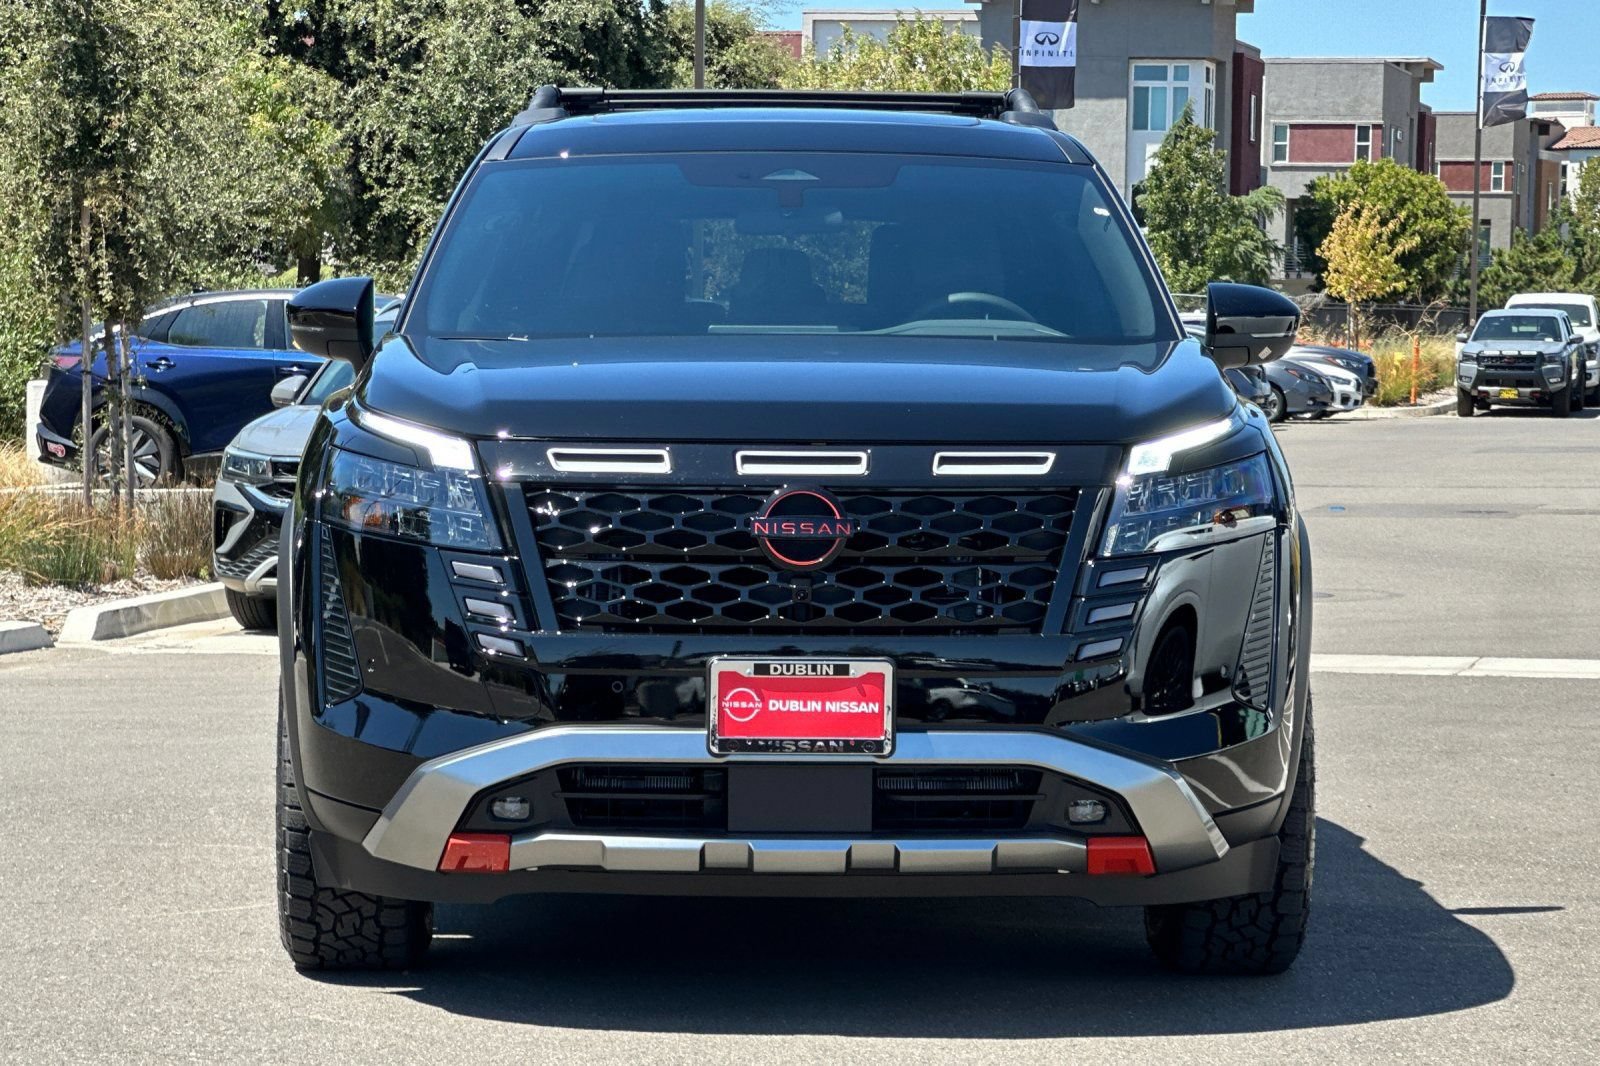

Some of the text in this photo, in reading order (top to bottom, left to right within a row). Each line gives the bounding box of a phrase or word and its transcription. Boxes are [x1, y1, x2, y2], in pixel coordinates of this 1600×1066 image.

[1021, 49, 1073, 57] INFINITI
[754, 522, 851, 535] NISSAN
[769, 663, 834, 675] DUBLIN
[768, 699, 879, 713] DUBLIN NISSAN
